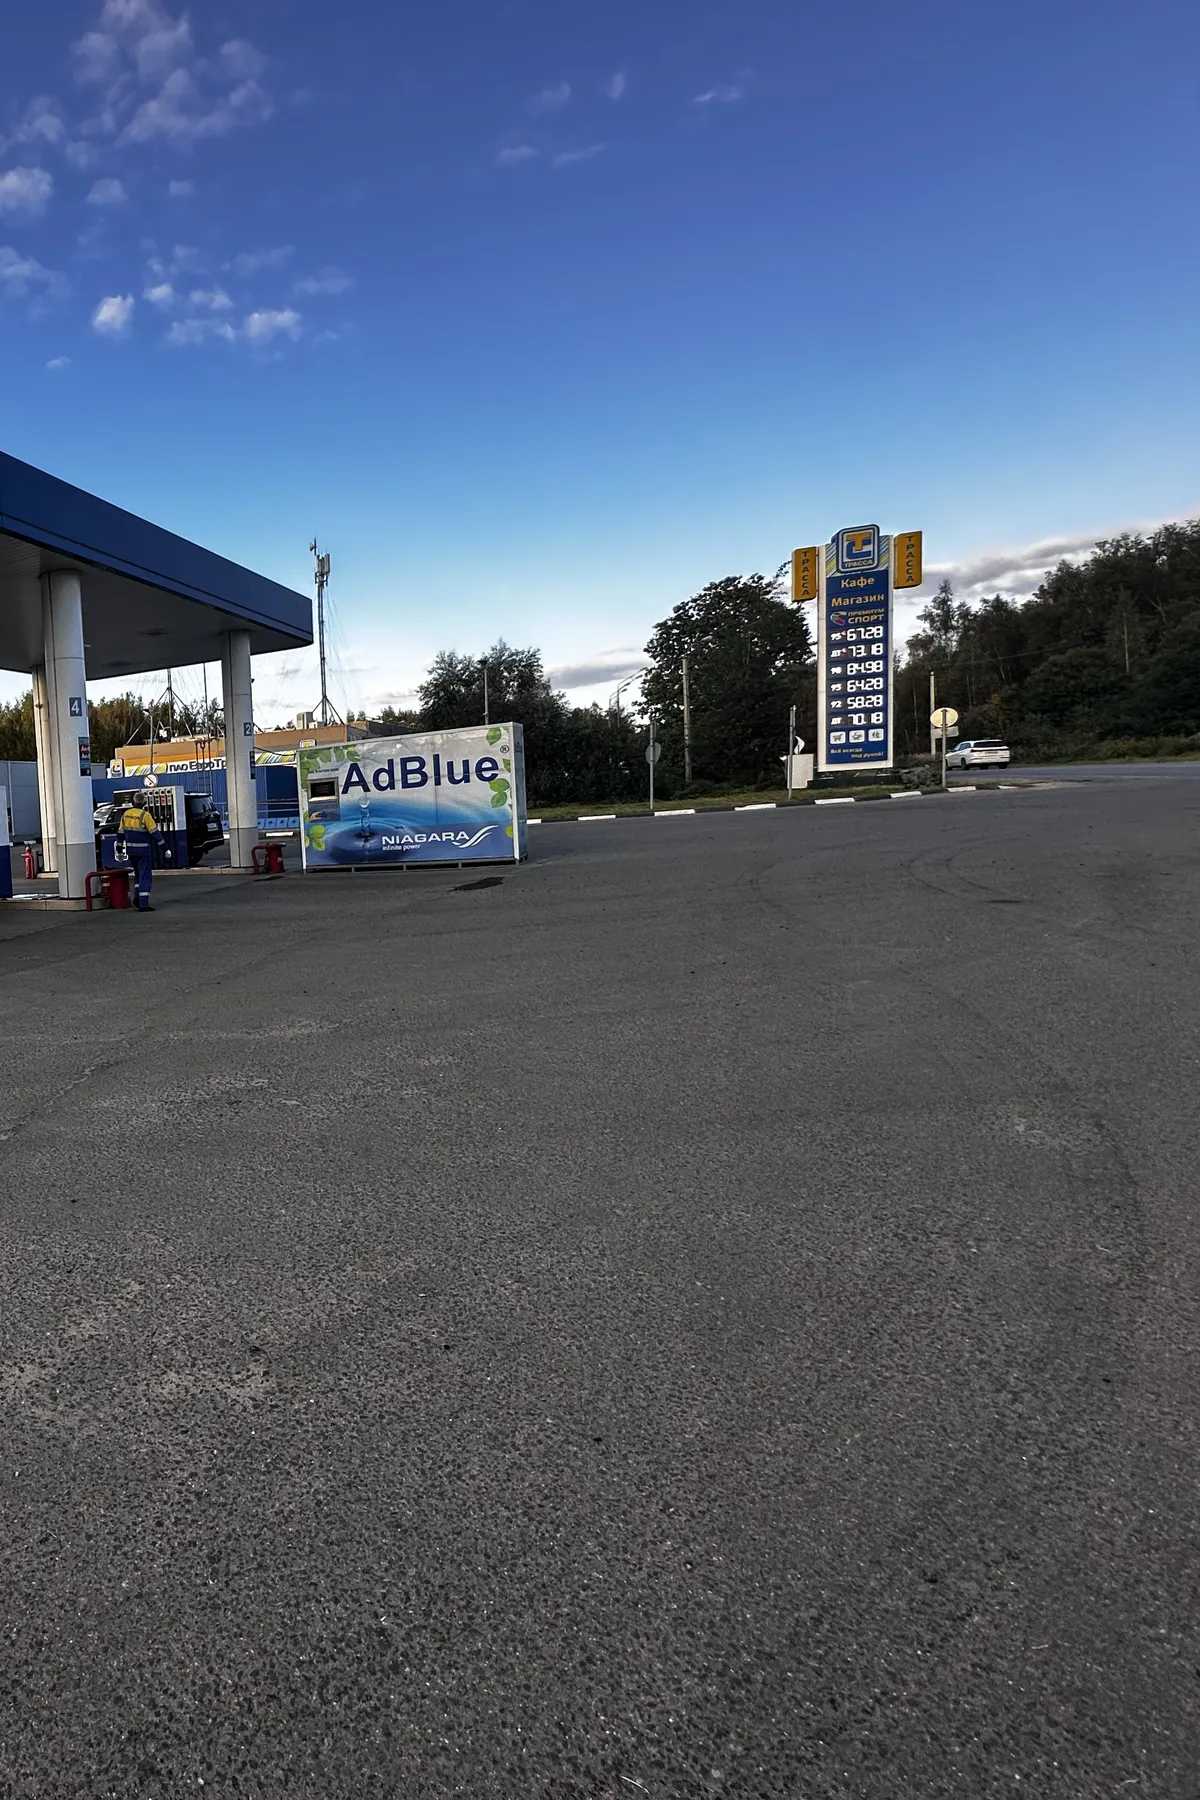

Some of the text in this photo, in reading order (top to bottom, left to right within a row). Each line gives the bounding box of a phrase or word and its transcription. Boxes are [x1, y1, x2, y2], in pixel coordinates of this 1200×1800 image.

[843, 560, 873, 568] ТРАССА
[905, 535, 915, 582] ТРАССА
[801, 551, 810, 596] ТРАССА
[841, 577, 875, 588] Кафе
[831, 595, 885, 607] Магазин
[848, 614, 885, 624] СПОРТ
[846, 626, 884, 641] 67.28
[846, 677, 884, 692] 64.28
[71, 700, 80, 714] 4
[846, 695, 884, 709] 58.28
[245, 724, 251, 735] 2
[169, 759, 227, 772] ПАО ЕвроТр
[341, 753, 499, 794] AdBlue
[382, 831, 470, 845] NIAGARA
